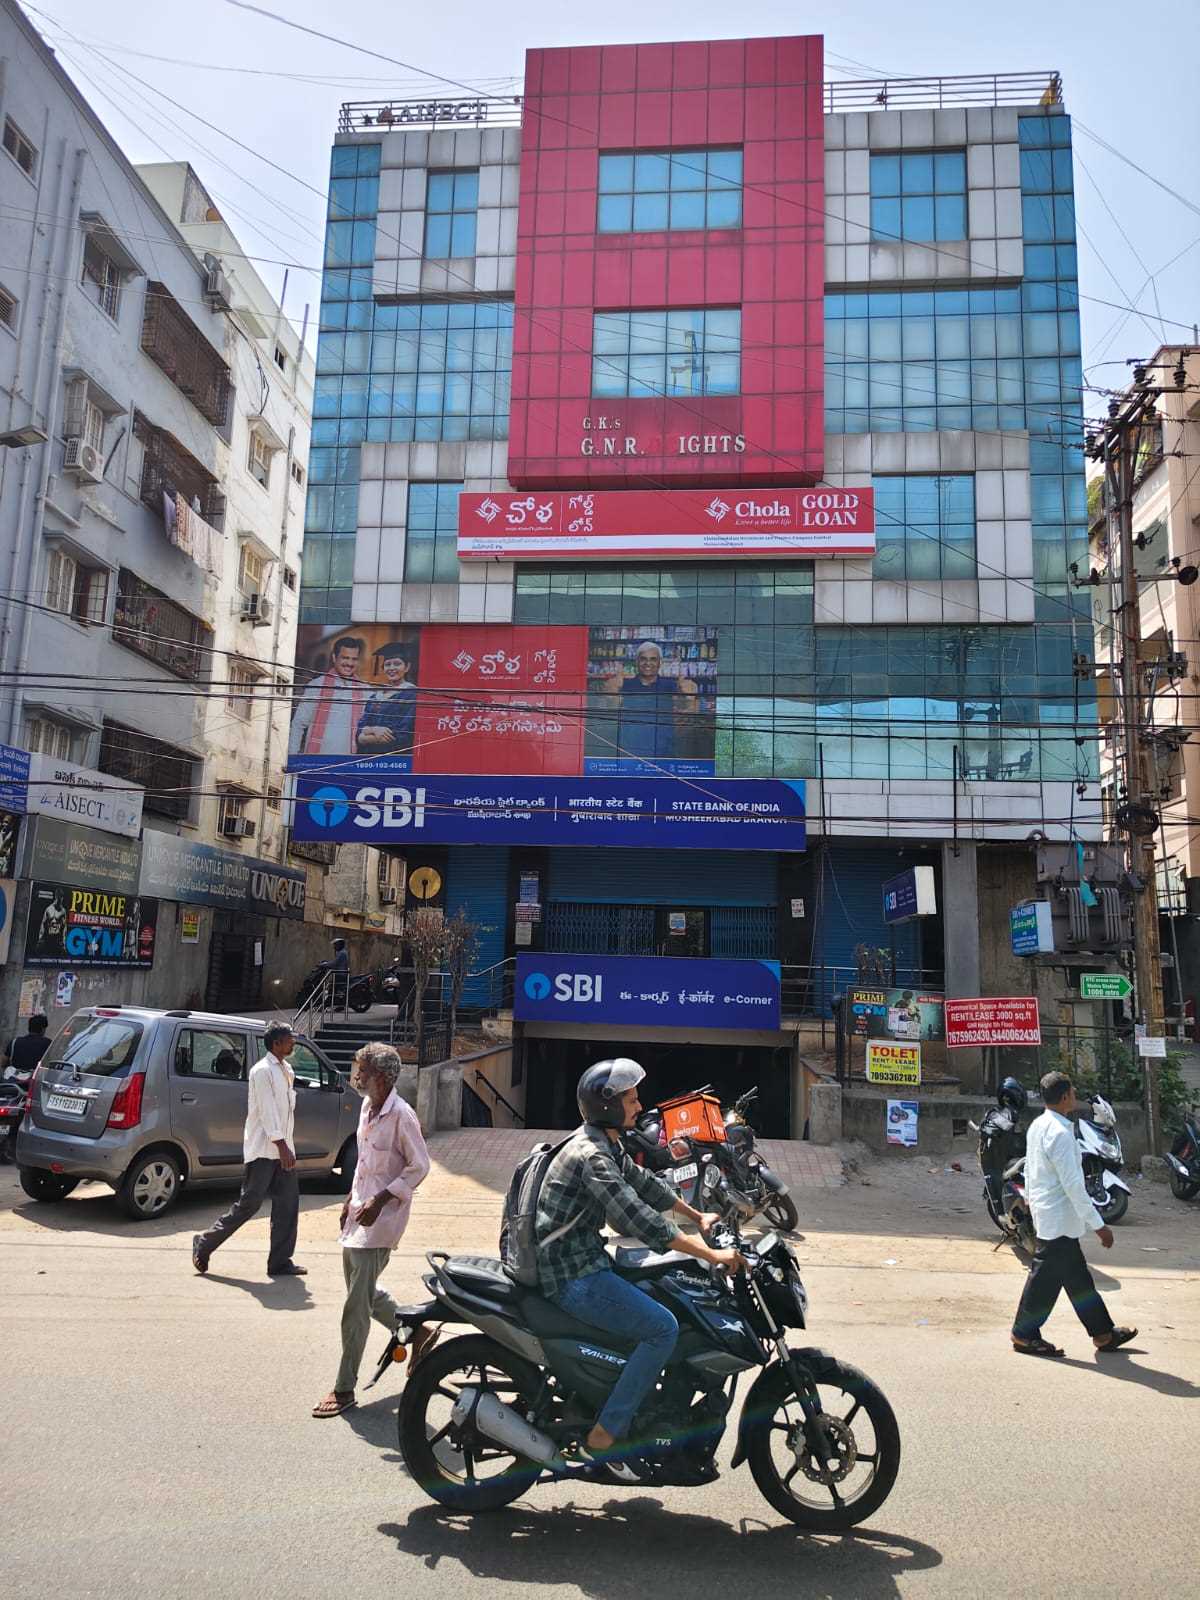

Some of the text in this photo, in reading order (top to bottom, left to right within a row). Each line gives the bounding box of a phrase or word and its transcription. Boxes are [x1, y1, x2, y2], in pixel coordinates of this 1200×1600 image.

[397, 103, 488, 122] AISECT
[679, 435, 746, 454] IGHTS
[735, 501, 790, 517] Chola
[802, 494, 859, 509] GOLD
[803, 511, 857, 526] LOAN
[54, 791, 105, 819] AISECT
[353, 786, 426, 828] SBI
[568, 796, 603, 807] भारतीय
[606, 796, 624, 808] स्टेट
[672, 801, 780, 813] STATE BANK OF INDIA
[251, 870, 305, 911] UNIQUE
[69, 890, 126, 917] PRIME
[65, 926, 124, 957] GYM
[554, 973, 602, 1002] SBI
[723, 994, 772, 1005] e-Corner
[853, 992, 886, 1003] PRIME
[998, 1001, 1025, 1009] Available
[1026, 1001, 1035, 1009] for
[852, 1004, 887, 1016] GYM
[870, 1045, 918, 1058] TOLET
[578, 1345, 628, 1367] RAIDER
[656, 1438, 671, 1446] TVS
